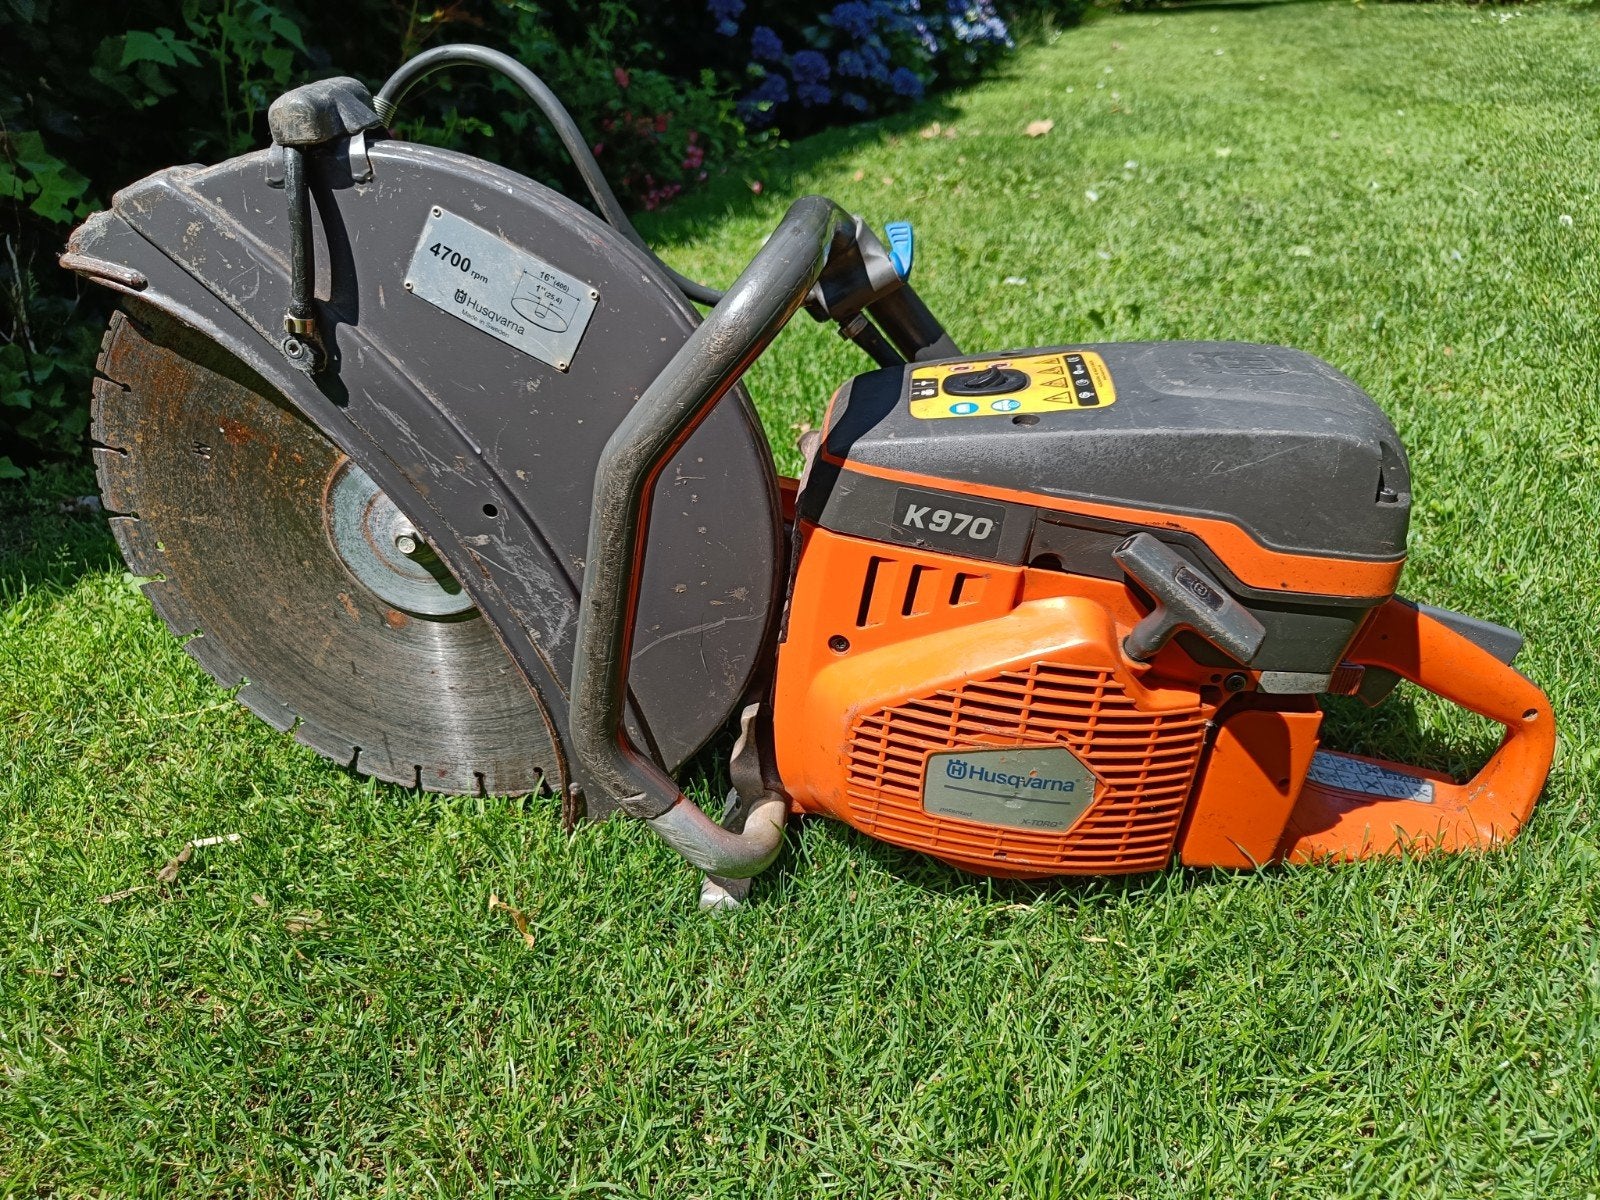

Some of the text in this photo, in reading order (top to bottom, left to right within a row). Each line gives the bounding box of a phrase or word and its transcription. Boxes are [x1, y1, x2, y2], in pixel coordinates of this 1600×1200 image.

[429, 242, 489, 284] 4700 rpm
[466, 296, 526, 336] Husqvarna
[485, 321, 510, 339] Sweden
[902, 503, 994, 540] K970
[968, 764, 1076, 793] Husqvarna
